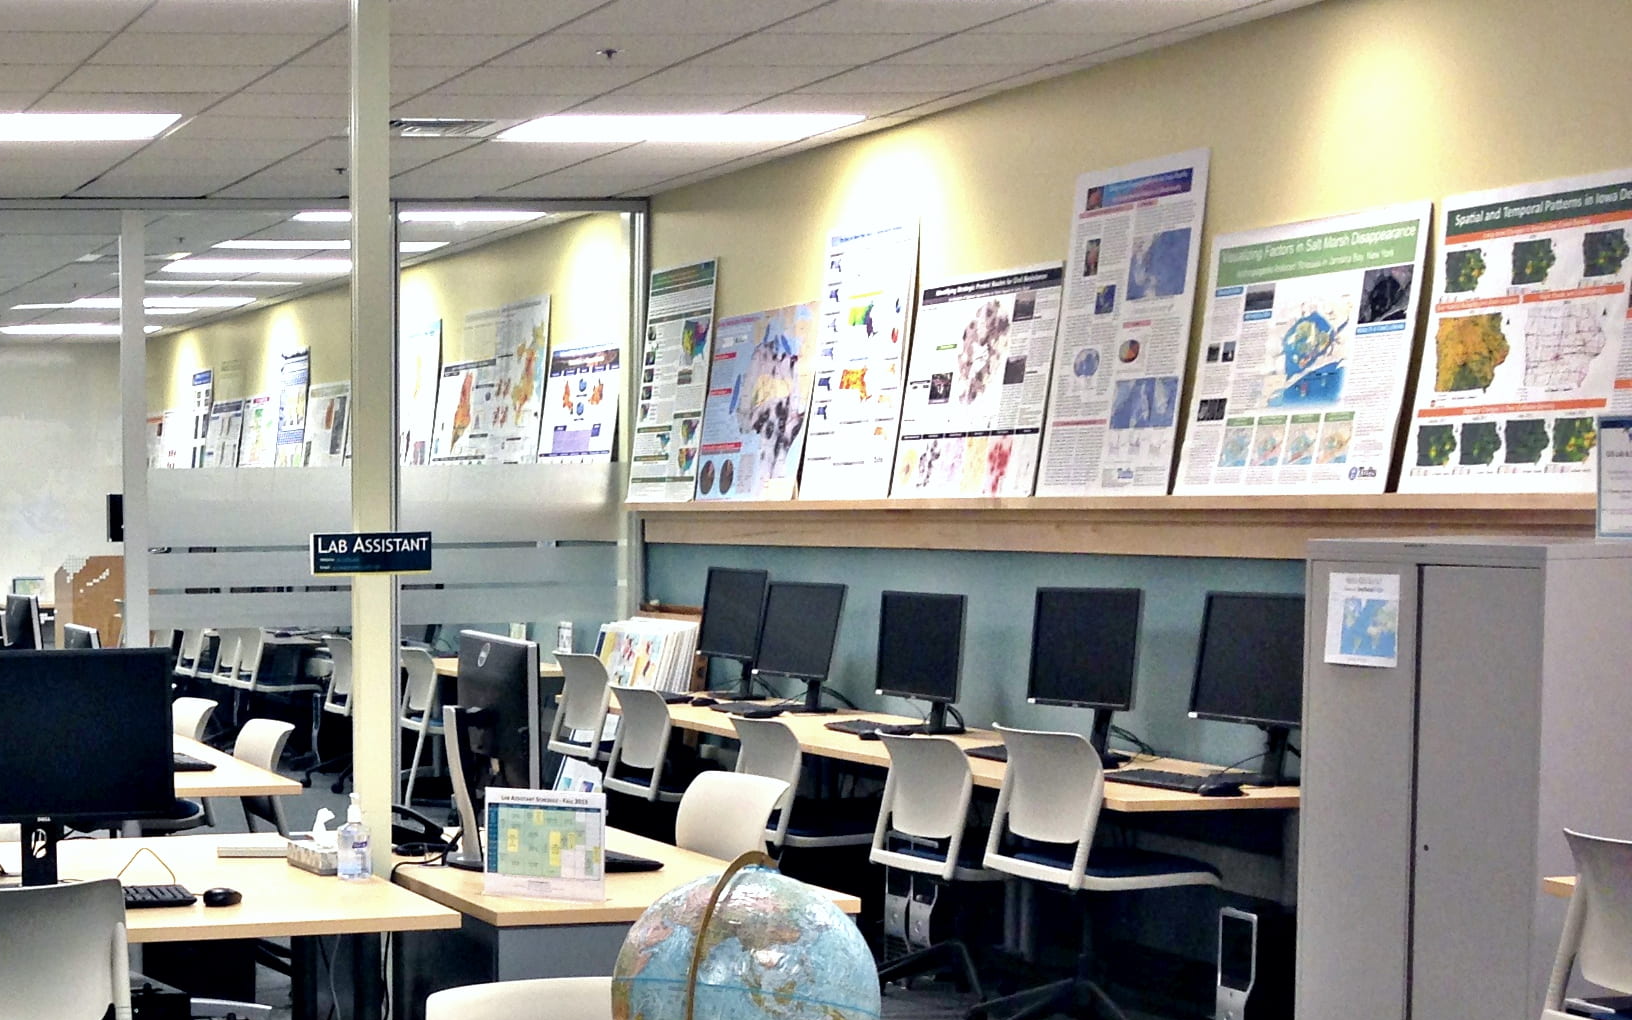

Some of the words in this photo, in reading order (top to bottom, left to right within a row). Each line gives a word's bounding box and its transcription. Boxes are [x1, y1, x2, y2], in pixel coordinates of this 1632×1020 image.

[1454, 210, 1484, 228] Spatial
[1484, 207, 1502, 222] and
[1503, 200, 1543, 219] Temporal
[1544, 196, 1582, 212] Patterns
[1324, 234, 1350, 249] Marsh
[1351, 224, 1417, 246] Disappearance
[317, 537, 348, 554] LAB
[353, 536, 429, 553] ASSISTANT
